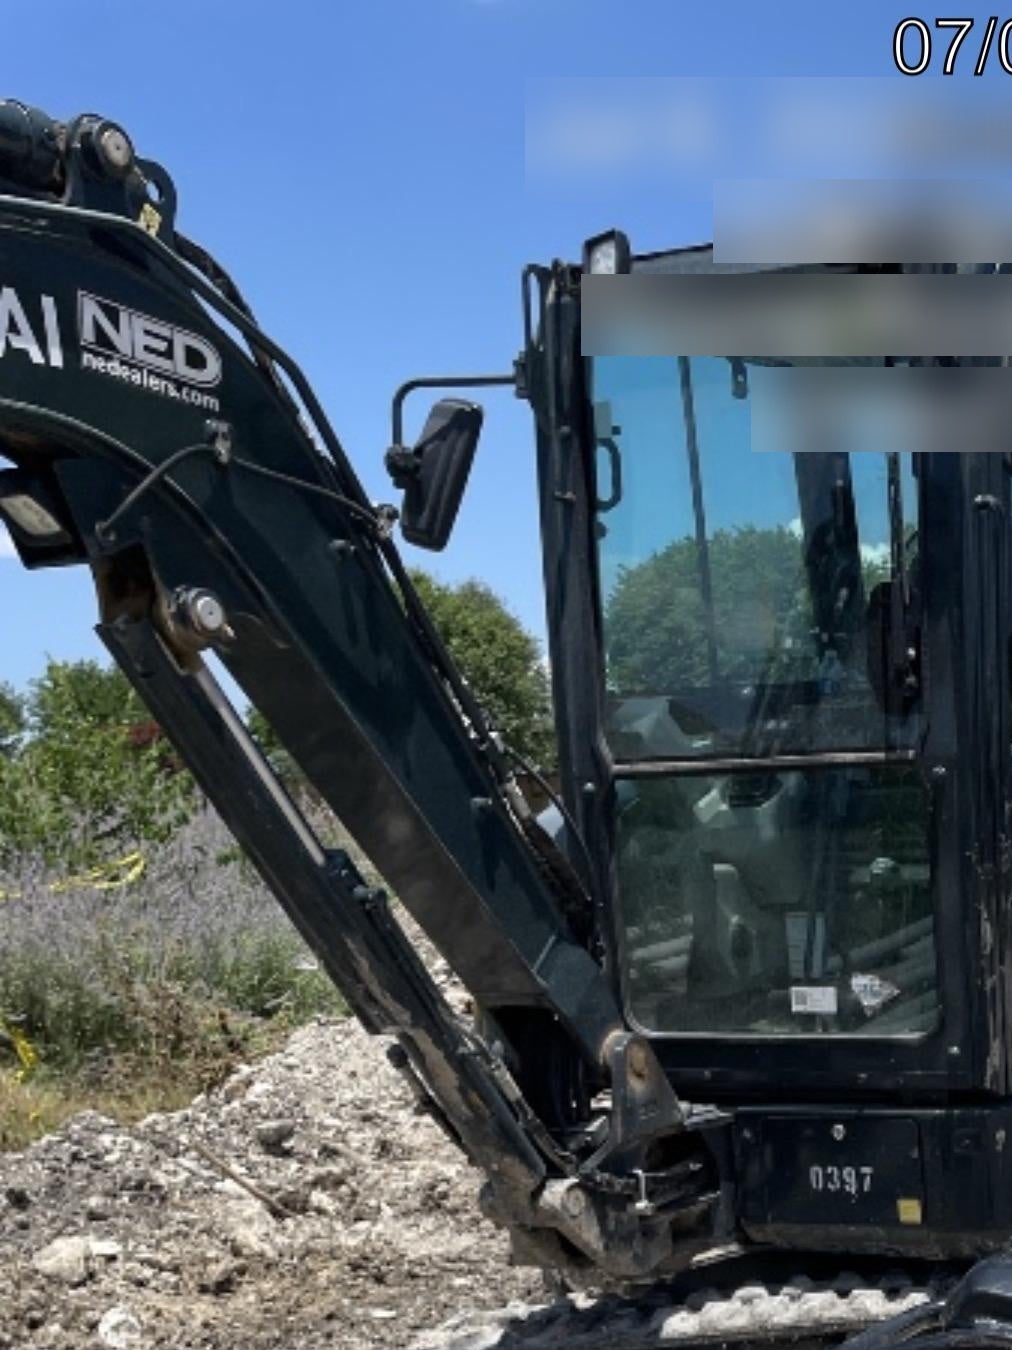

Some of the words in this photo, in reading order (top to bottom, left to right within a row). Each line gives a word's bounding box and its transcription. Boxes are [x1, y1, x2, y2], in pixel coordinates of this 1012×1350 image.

[78, 289, 222, 387] NED
[81, 351, 220, 412] nedealers.com
[808, 1166, 874, 1194] 0397
